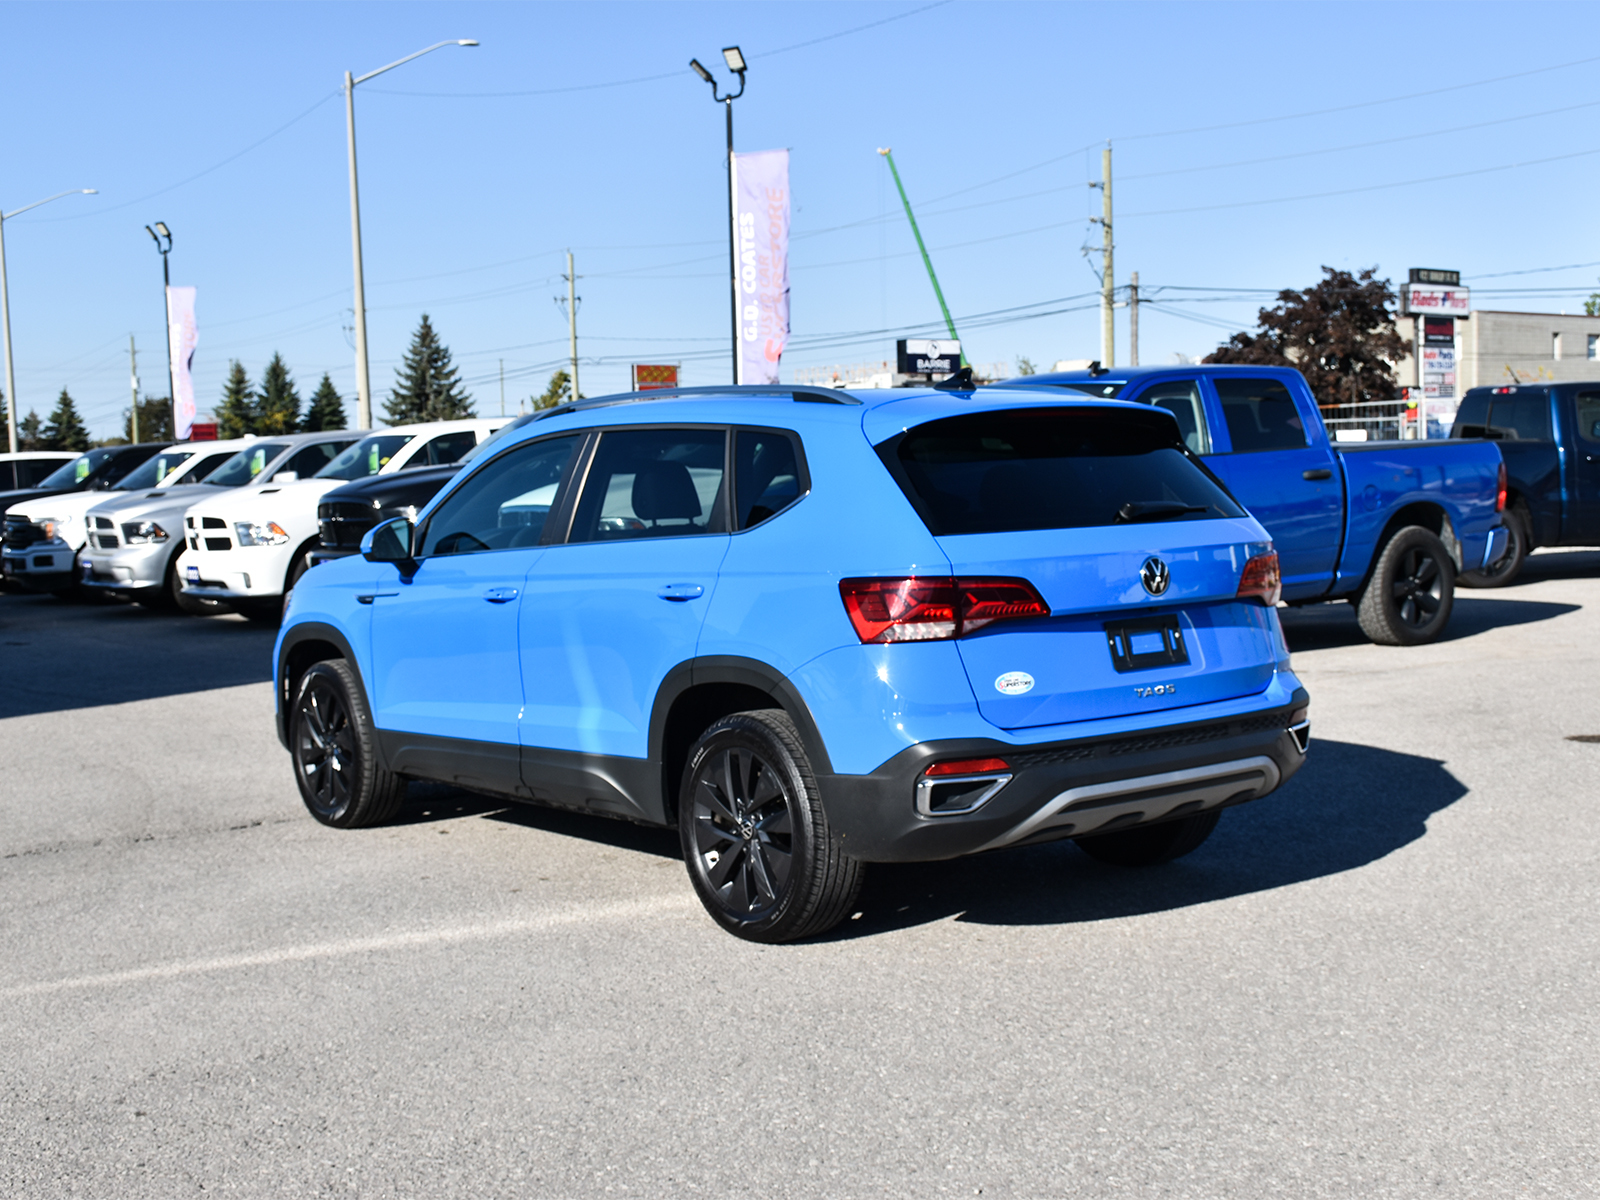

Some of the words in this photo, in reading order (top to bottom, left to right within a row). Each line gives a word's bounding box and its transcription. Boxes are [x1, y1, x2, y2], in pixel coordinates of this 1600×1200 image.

[739, 213, 758, 294] COATES
[758, 254, 770, 288] CAR
[743, 299, 760, 342] G.D.
[759, 292, 773, 337] USED
[1134, 684, 1176, 698] TAOS
